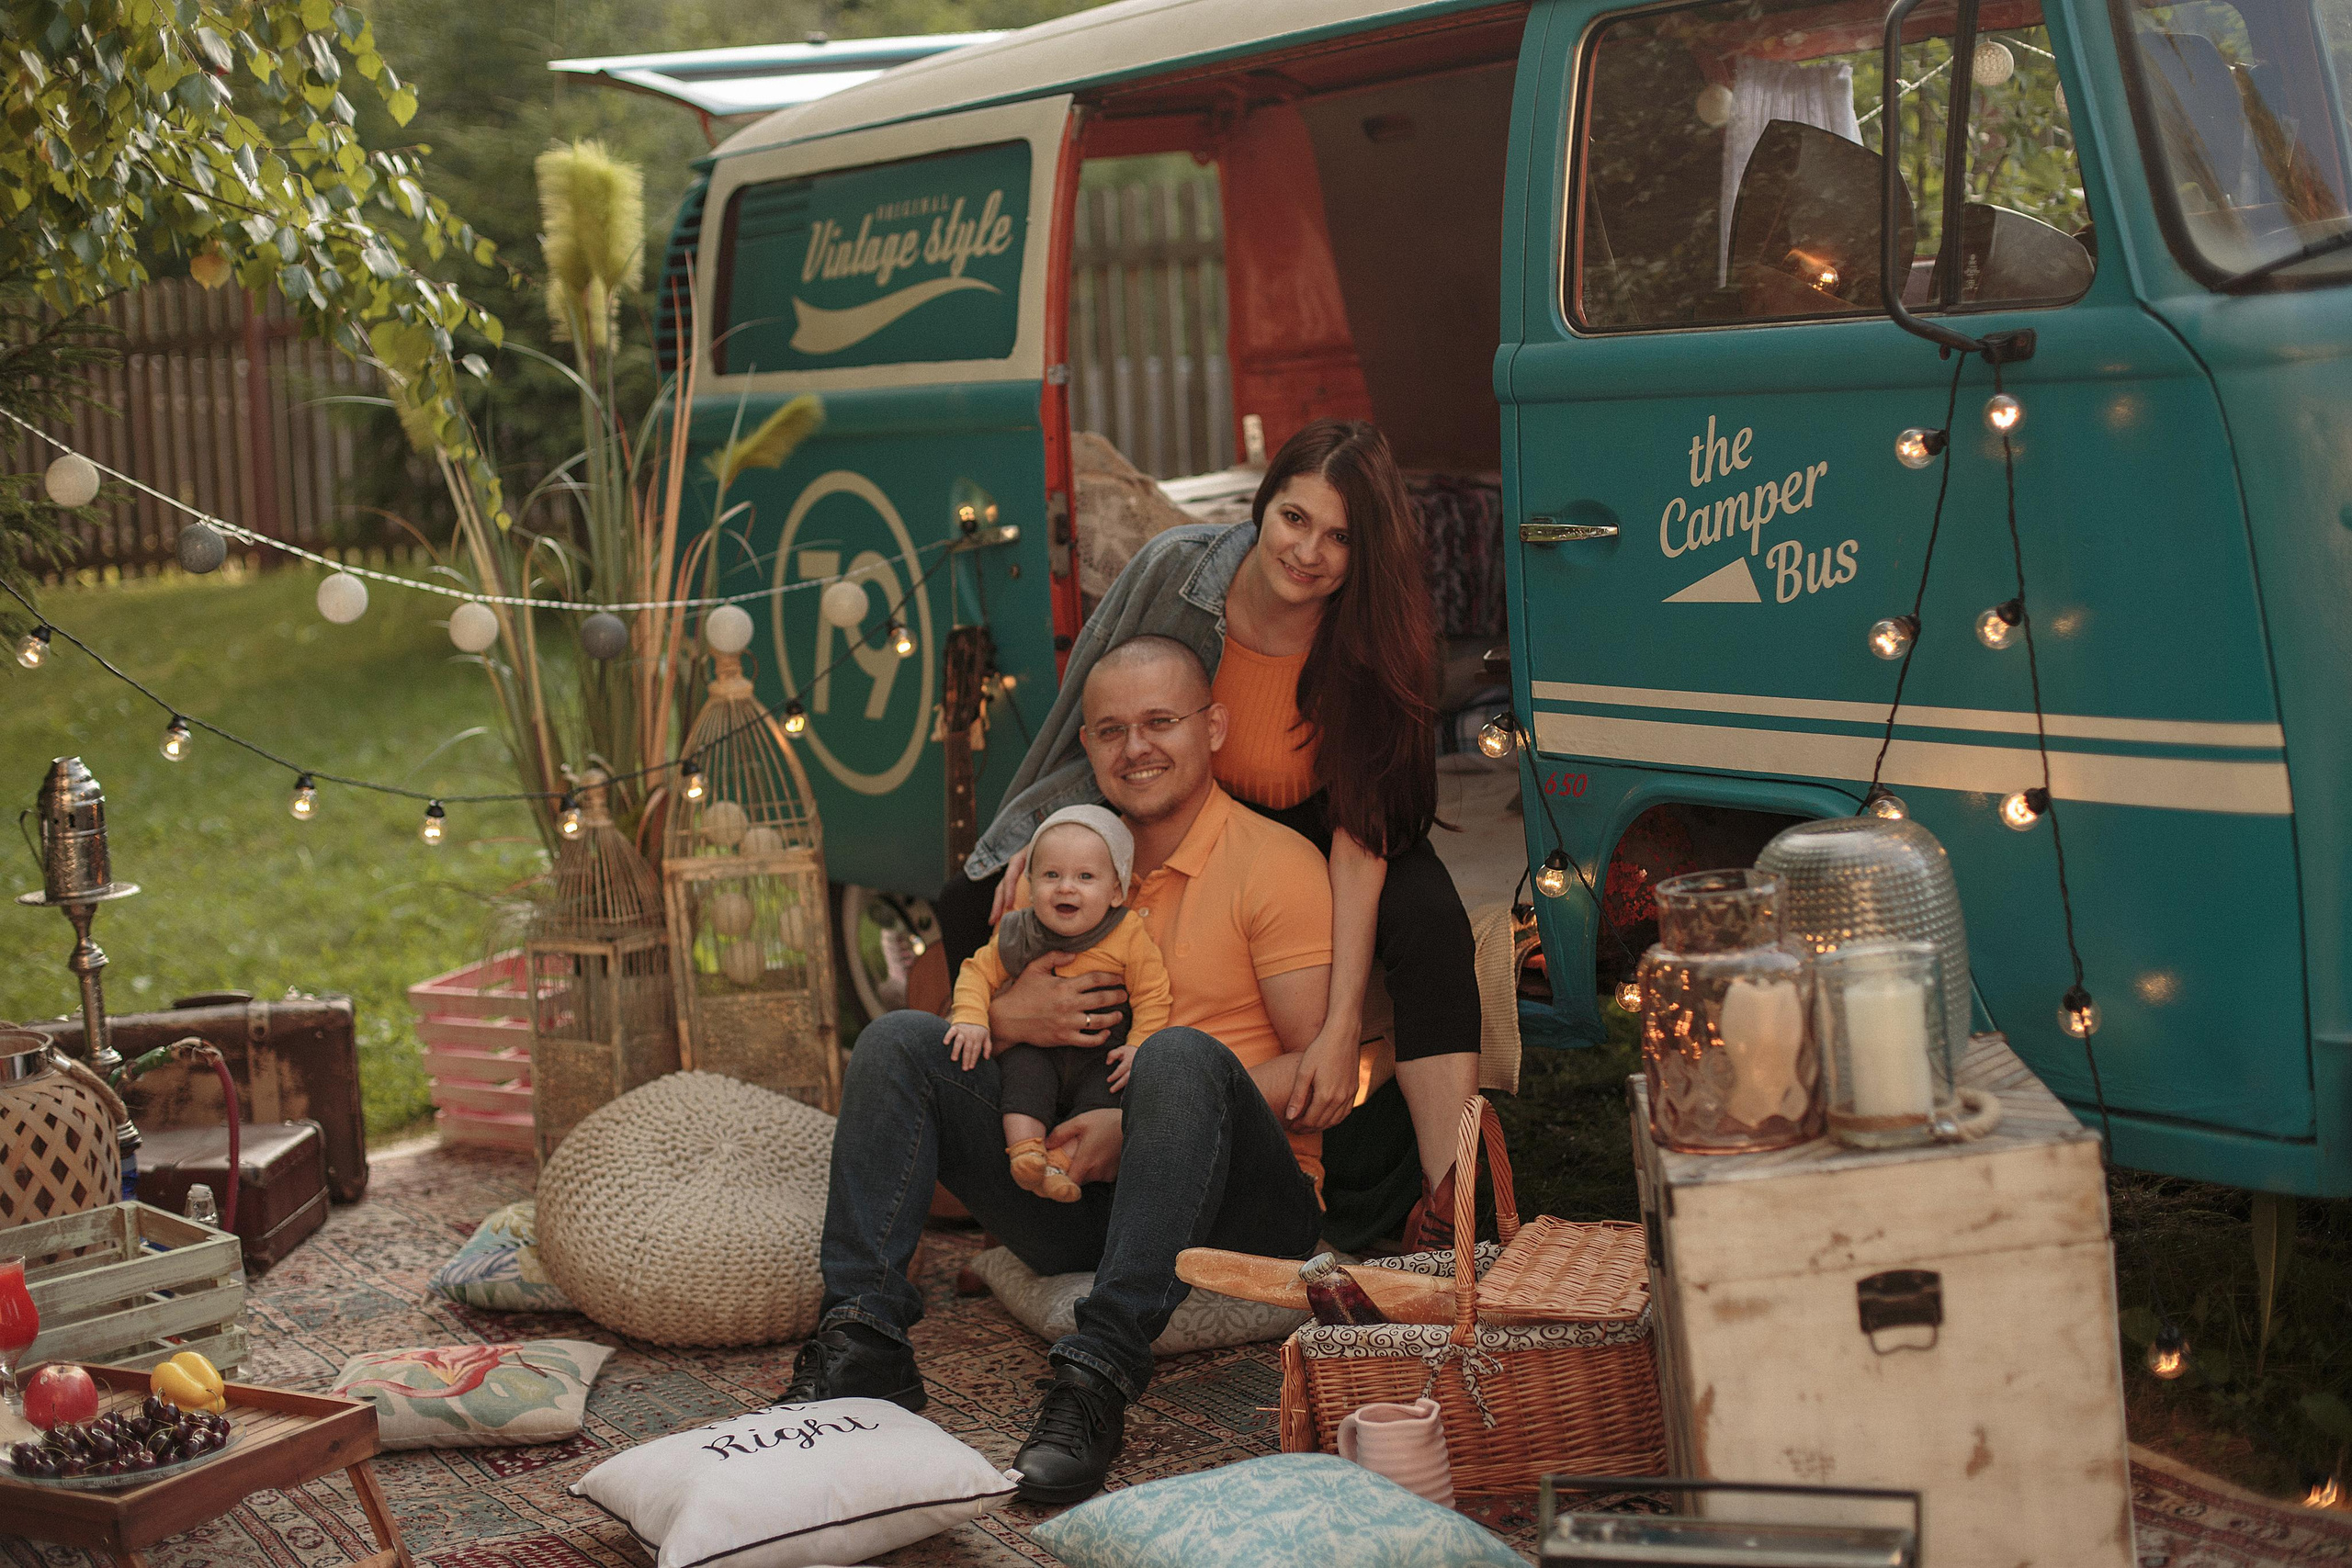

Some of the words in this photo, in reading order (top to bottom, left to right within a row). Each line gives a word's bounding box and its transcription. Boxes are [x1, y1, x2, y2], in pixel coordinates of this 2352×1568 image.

[801, 219, 920, 288] Vintage
[923, 189, 1013, 277] style
[1688, 414, 1754, 488] the
[1659, 460, 1828, 558] Camper
[1765, 539, 1860, 604] Bus
[1544, 771, 1589, 798] 650
[701, 1416, 879, 1461] Right
